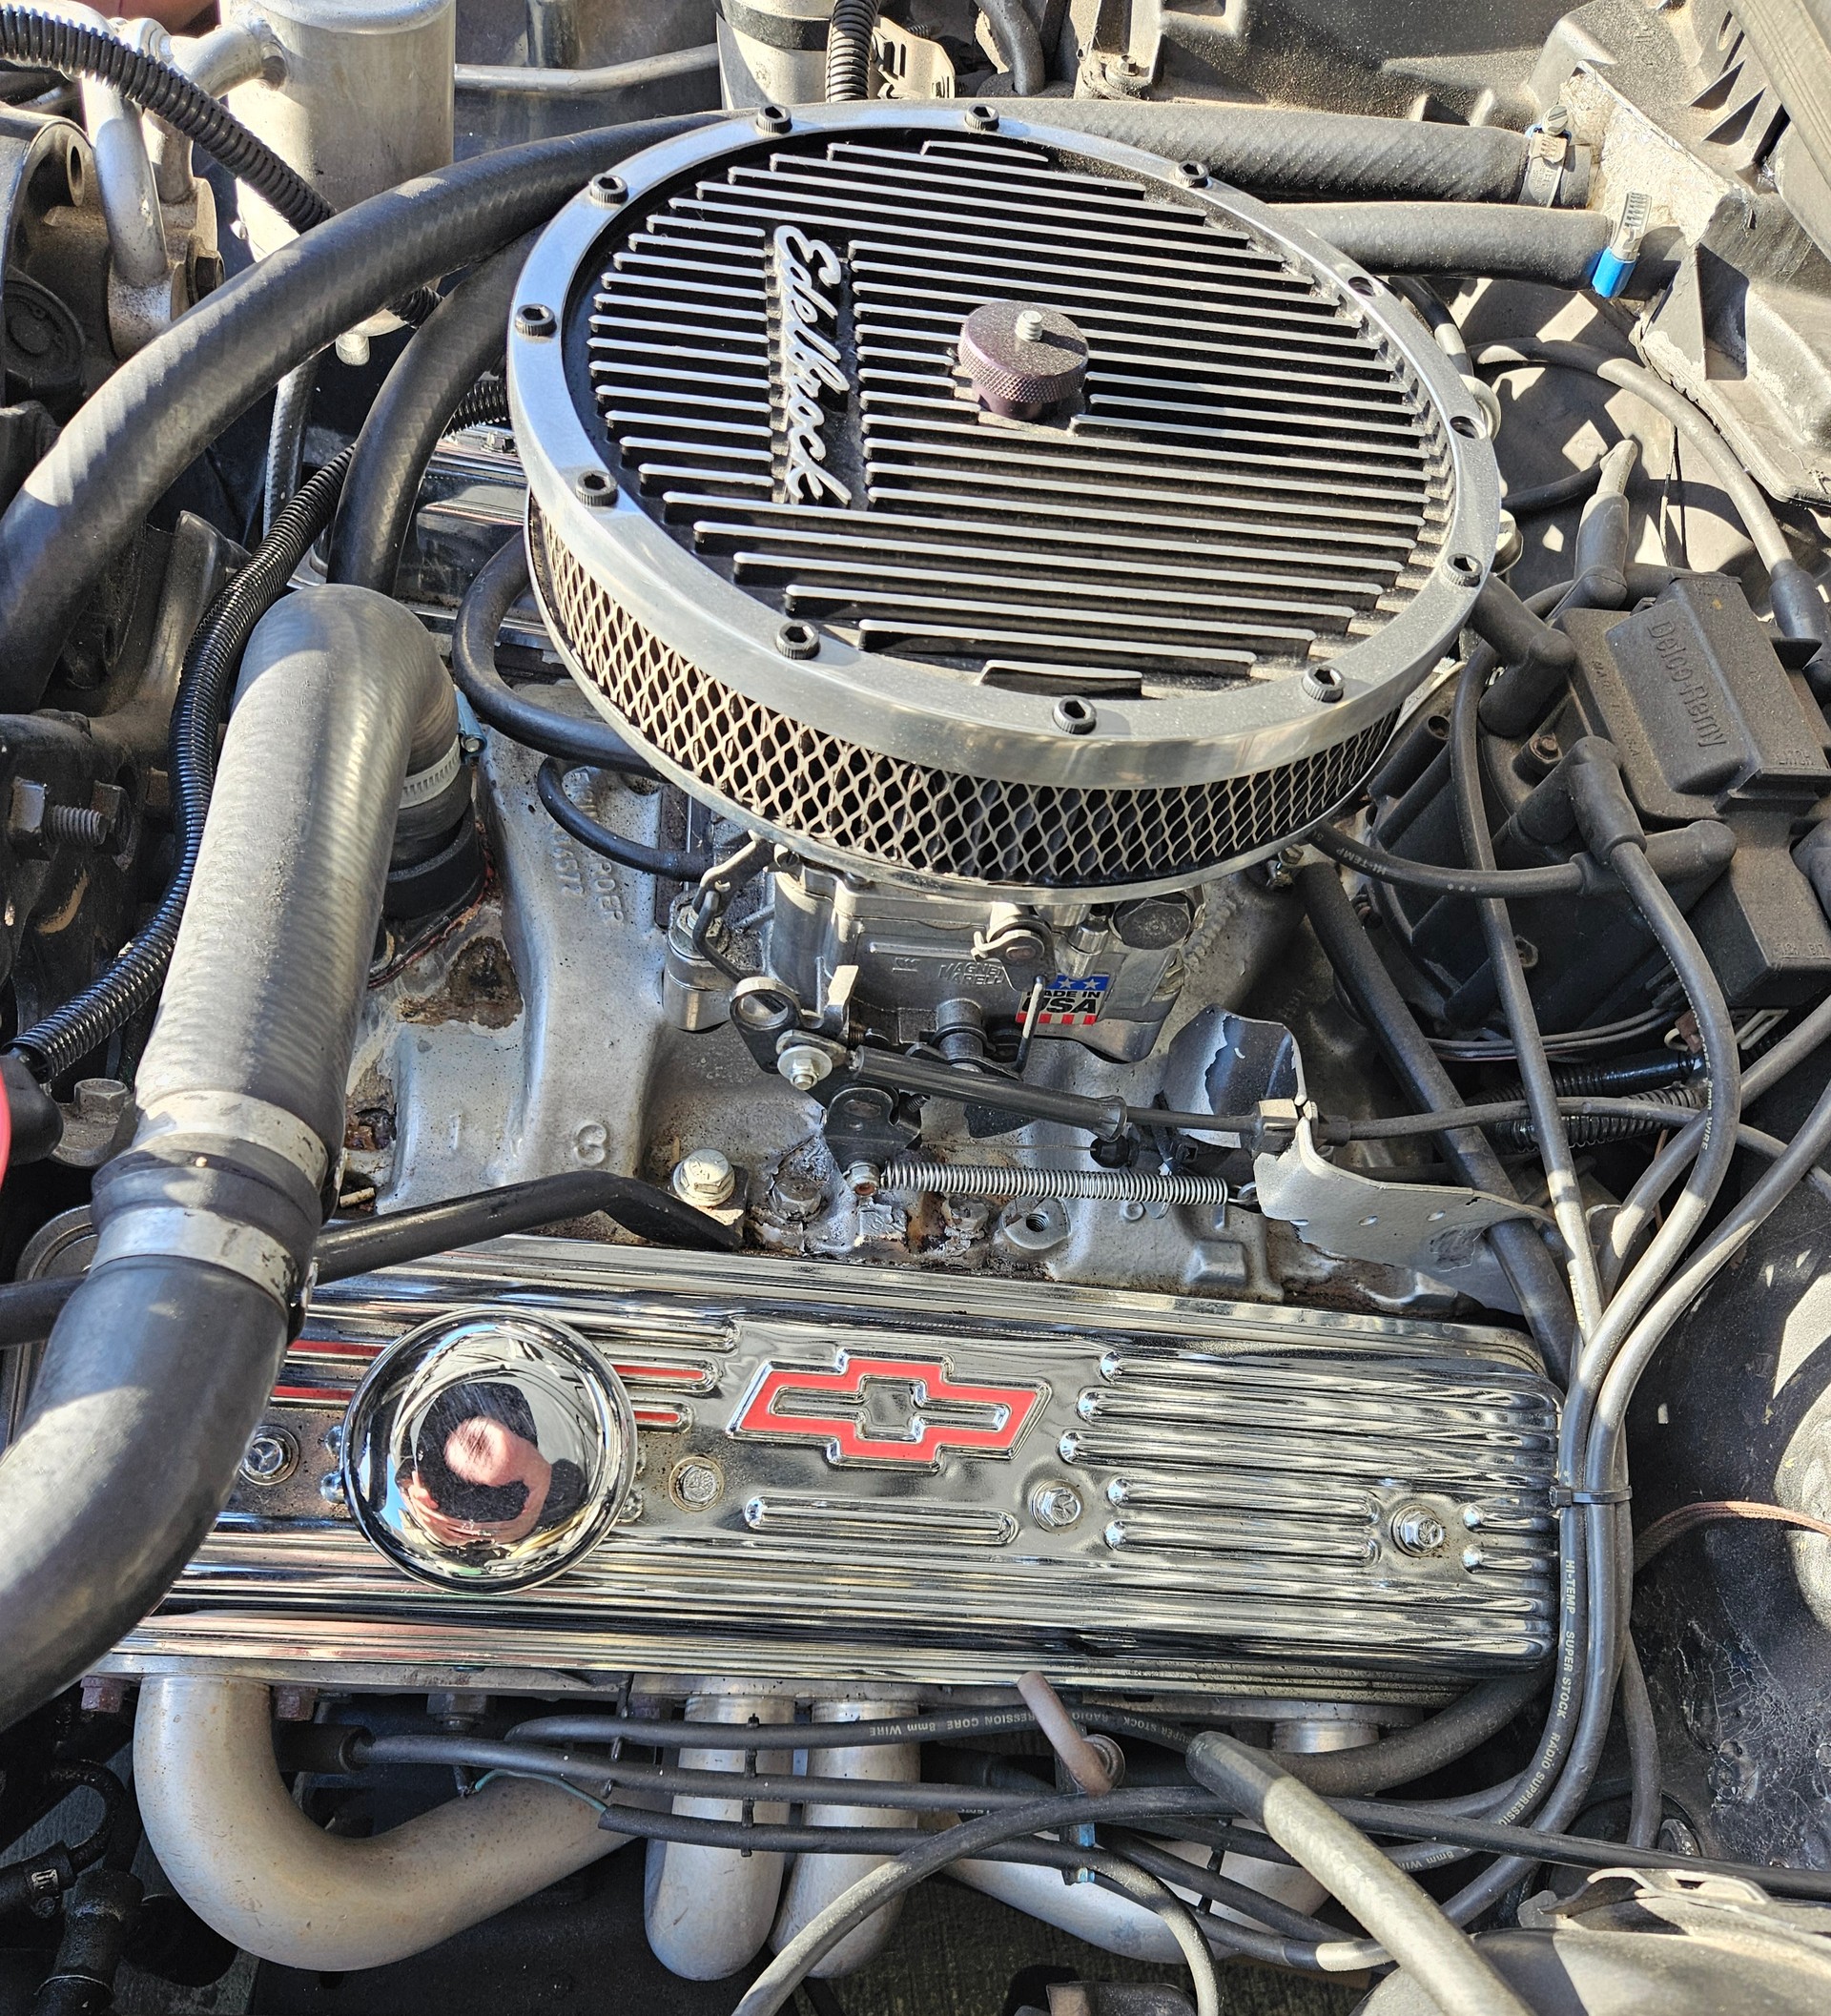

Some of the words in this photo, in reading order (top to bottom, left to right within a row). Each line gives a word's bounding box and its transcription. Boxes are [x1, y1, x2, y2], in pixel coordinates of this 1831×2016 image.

[773, 225, 852, 505] Edelbrock
[1647, 621, 1728, 749] Delco-Remy
[1081, 990, 1101, 998] IN
[1021, 998, 1097, 1014] USA
[1565, 1559, 1576, 1615] HI-TEMP
[1564, 1631, 1575, 1673] SUPER
[1555, 1677, 1573, 1719] STOCK
[946, 1718, 979, 1731] CORE
[1071, 1712, 1109, 1725] RADIO
[1121, 1716, 1160, 1734] STOCK
[869, 1724, 902, 1737] WIRE
[906, 1722, 936, 1733] 8mm
[1541, 1732, 1561, 1769] RADIO
[1399, 1860, 1423, 1872] WIR
